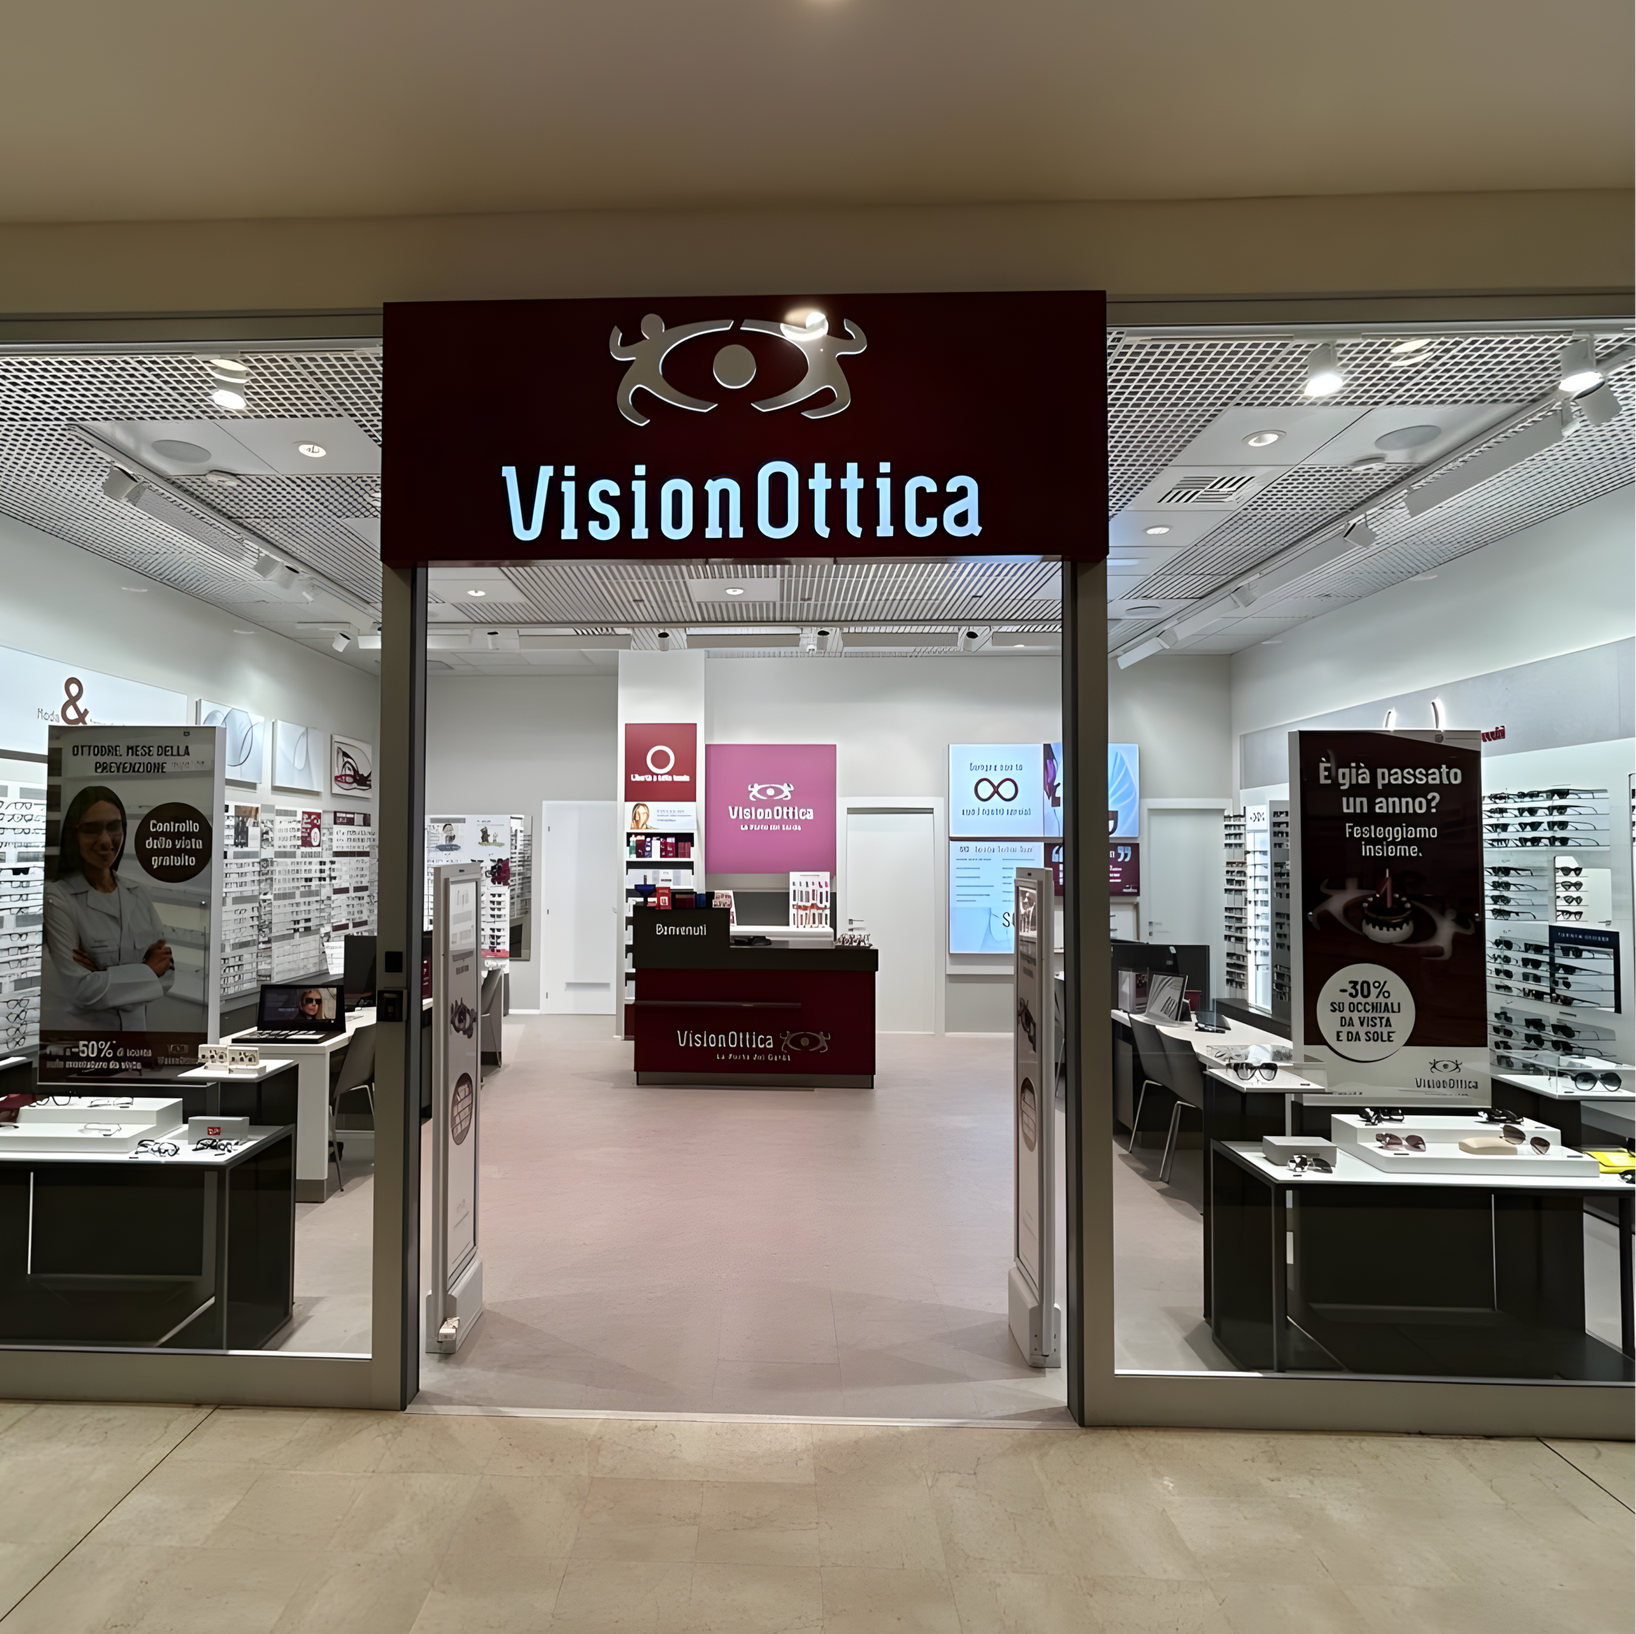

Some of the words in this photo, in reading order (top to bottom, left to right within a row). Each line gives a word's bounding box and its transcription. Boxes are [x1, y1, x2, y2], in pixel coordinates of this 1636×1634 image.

[501, 460, 983, 541] VisionOttica
[1319, 757, 1332, 784] È
[1337, 762, 1371, 790] già
[1376, 764, 1463, 790] passato
[1342, 797, 1368, 813] un
[1375, 792, 1441, 814] anno?
[1345, 823, 1438, 842] Festeggiamo
[1361, 841, 1423, 857] insieme.
[1339, 980, 1391, 999] -30%
[1329, 1001, 1345, 1013] SU
[1348, 1001, 1401, 1013] OCCHIALI
[1340, 1016, 1355, 1028] DA
[1358, 1016, 1392, 1028] VISTA
[676, 1029, 774, 1049] VisionOttica
[1336, 1030, 1343, 1042] E
[1346, 1030, 1361, 1042] DA
[1364, 1030, 1396, 1042] SOLE
